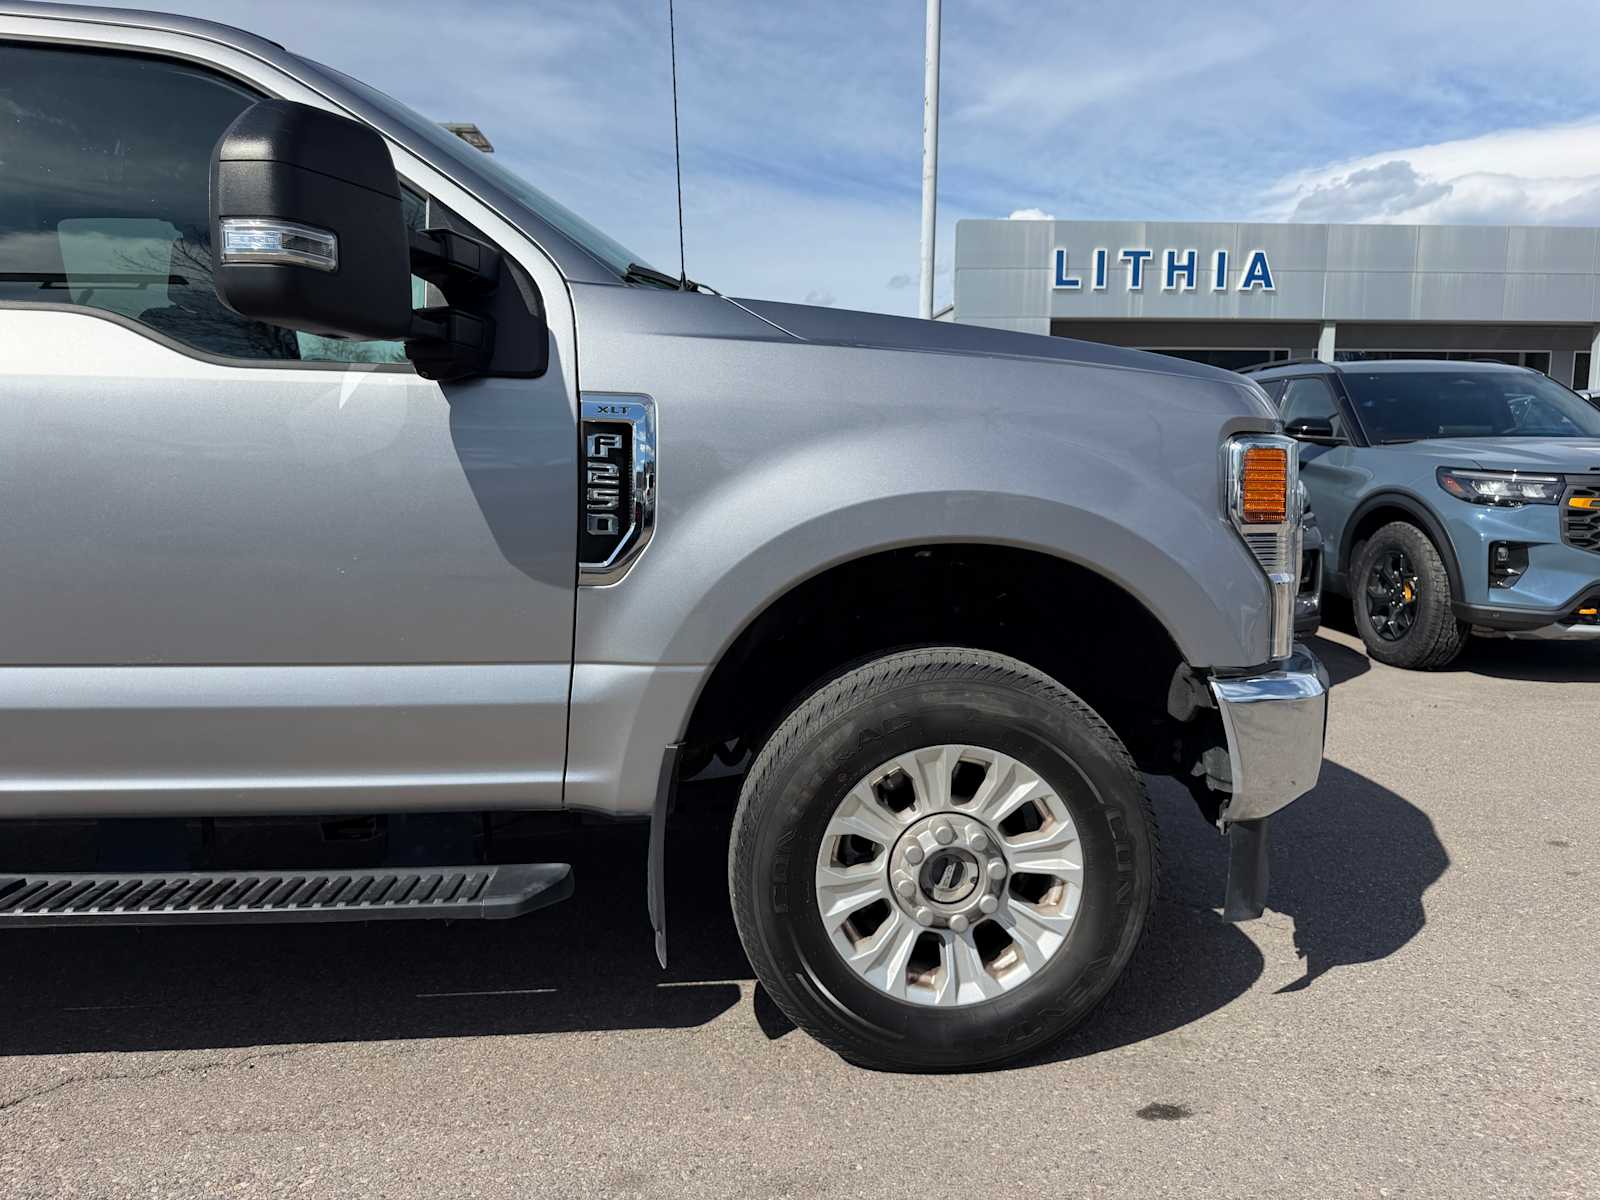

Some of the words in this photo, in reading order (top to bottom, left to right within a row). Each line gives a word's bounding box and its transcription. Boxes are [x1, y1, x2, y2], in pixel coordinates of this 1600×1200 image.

[1051, 248, 1276, 292] LITHIA
[597, 406, 630, 414] XLT
[586, 433, 623, 536] F250
